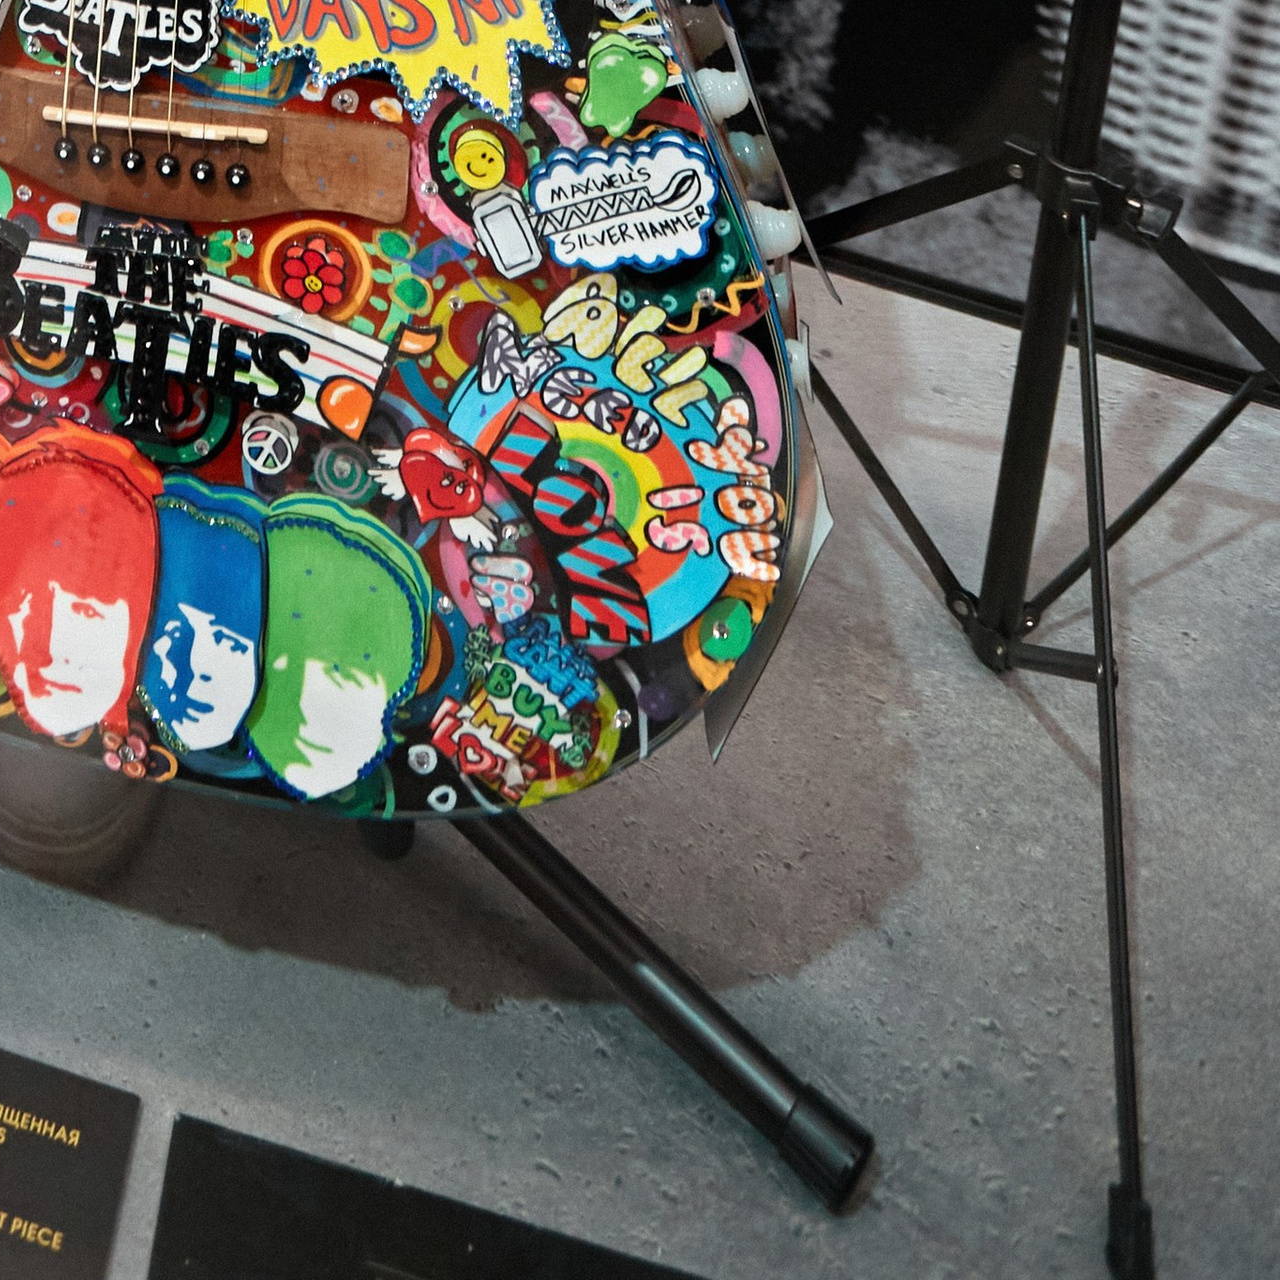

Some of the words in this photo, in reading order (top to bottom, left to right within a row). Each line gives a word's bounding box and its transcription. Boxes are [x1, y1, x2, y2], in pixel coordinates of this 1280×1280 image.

[560, 222, 636, 256] SILVER
[638, 204, 711, 242] HAMMER
[86, 246, 208, 316] THE
[478, 314, 662, 453] NEED
[542, 290, 708, 429] ALL
[489, 414, 652, 647] LOVE
[646, 485, 713, 557] IS
[687, 418, 782, 582] YOU
[471, 699, 534, 755] ME
[484, 662, 573, 742] BUY
[9, 1216, 65, 1253] PIECE
